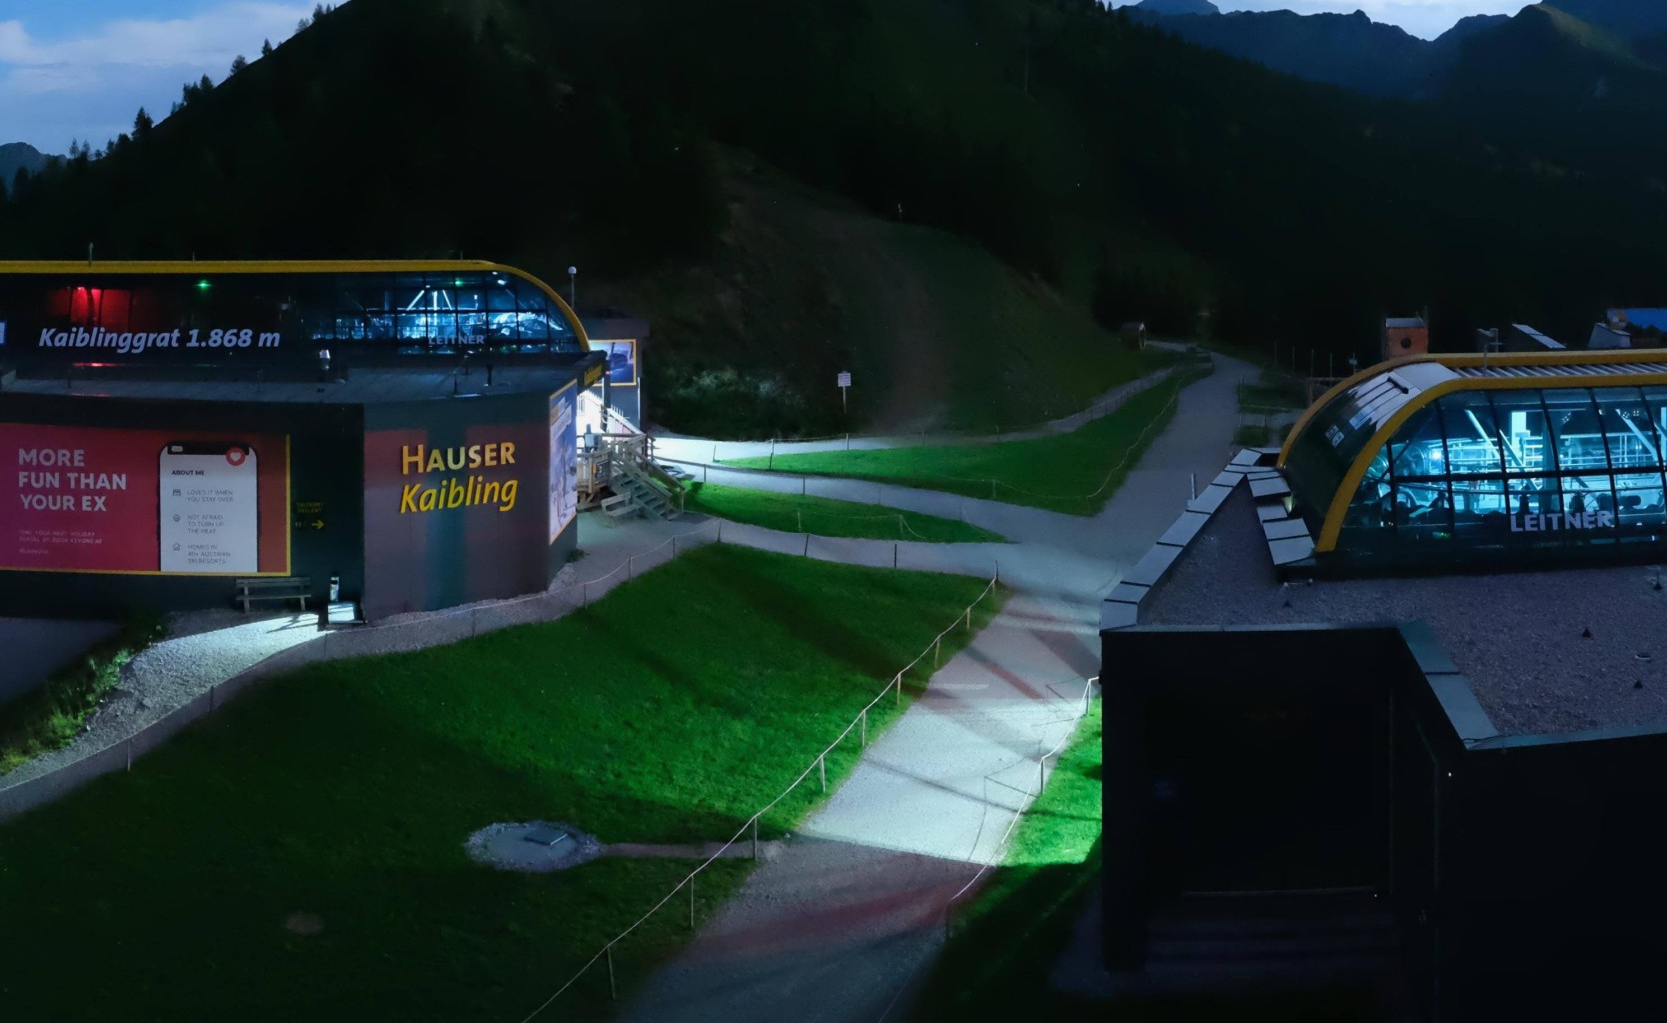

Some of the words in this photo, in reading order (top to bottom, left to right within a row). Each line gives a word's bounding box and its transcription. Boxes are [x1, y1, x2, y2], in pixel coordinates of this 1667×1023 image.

[38, 326, 181, 354] Kaiblinggrat
[185, 328, 253, 348] 1.868
[258, 331, 281, 348] m
[428, 334, 485, 346] LEITNER
[18, 448, 86, 467] MORE
[402, 441, 516, 475] HAUSER
[18, 471, 60, 489] FUN
[66, 472, 127, 490] THAN
[20, 494, 76, 511] YOUR
[81, 496, 107, 512] EX
[400, 475, 519, 514] Kaibling
[1510, 510, 1614, 533] LEITNER
